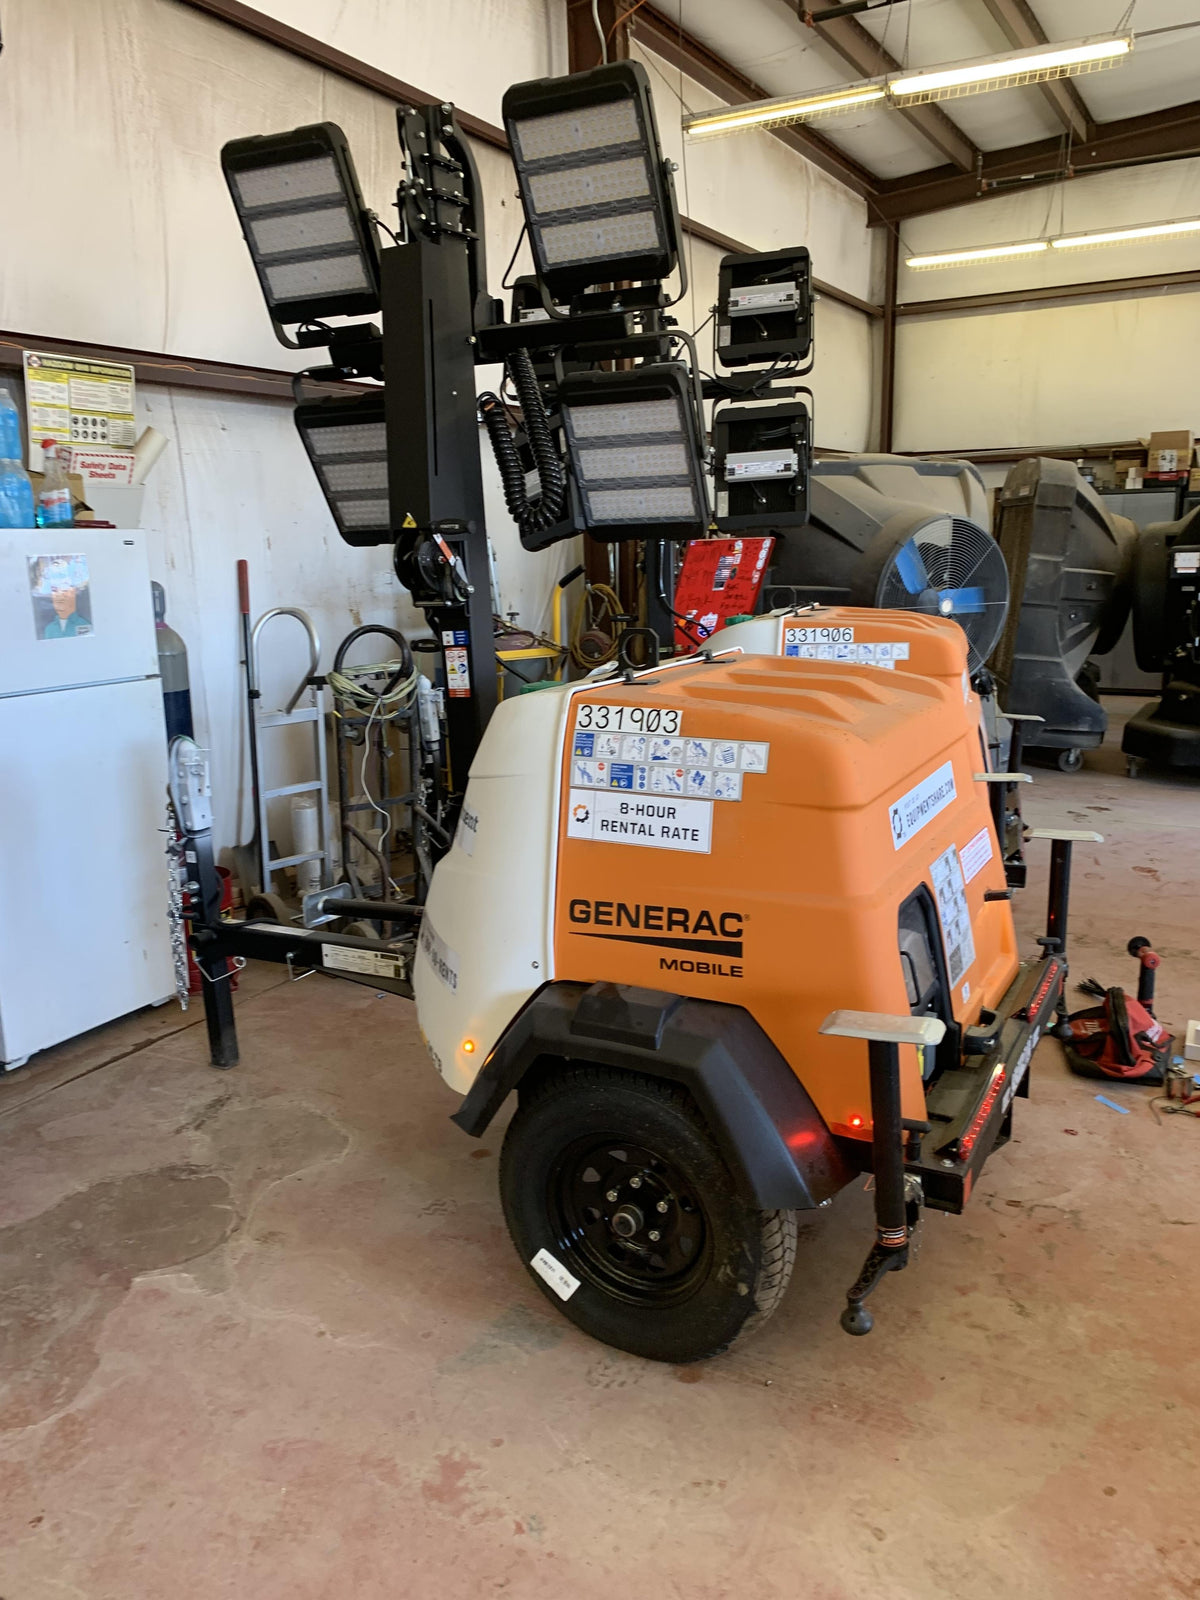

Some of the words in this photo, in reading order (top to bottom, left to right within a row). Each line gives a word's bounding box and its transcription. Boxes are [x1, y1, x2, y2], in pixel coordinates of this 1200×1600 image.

[80, 461, 106, 470] Safety
[108, 463, 127, 471] Data
[88, 470, 116, 479] Sheets
[787, 627, 852, 642] 331906
[578, 705, 679, 734] 331903
[620, 802, 676, 819] 8-HOUR
[906, 778, 954, 828] EQUIPMENTSHARE.COM
[600, 819, 655, 837] RENTAL
[661, 825, 700, 841] RATE
[569, 899, 743, 938] GENERAC
[660, 958, 743, 978] MOBILE
